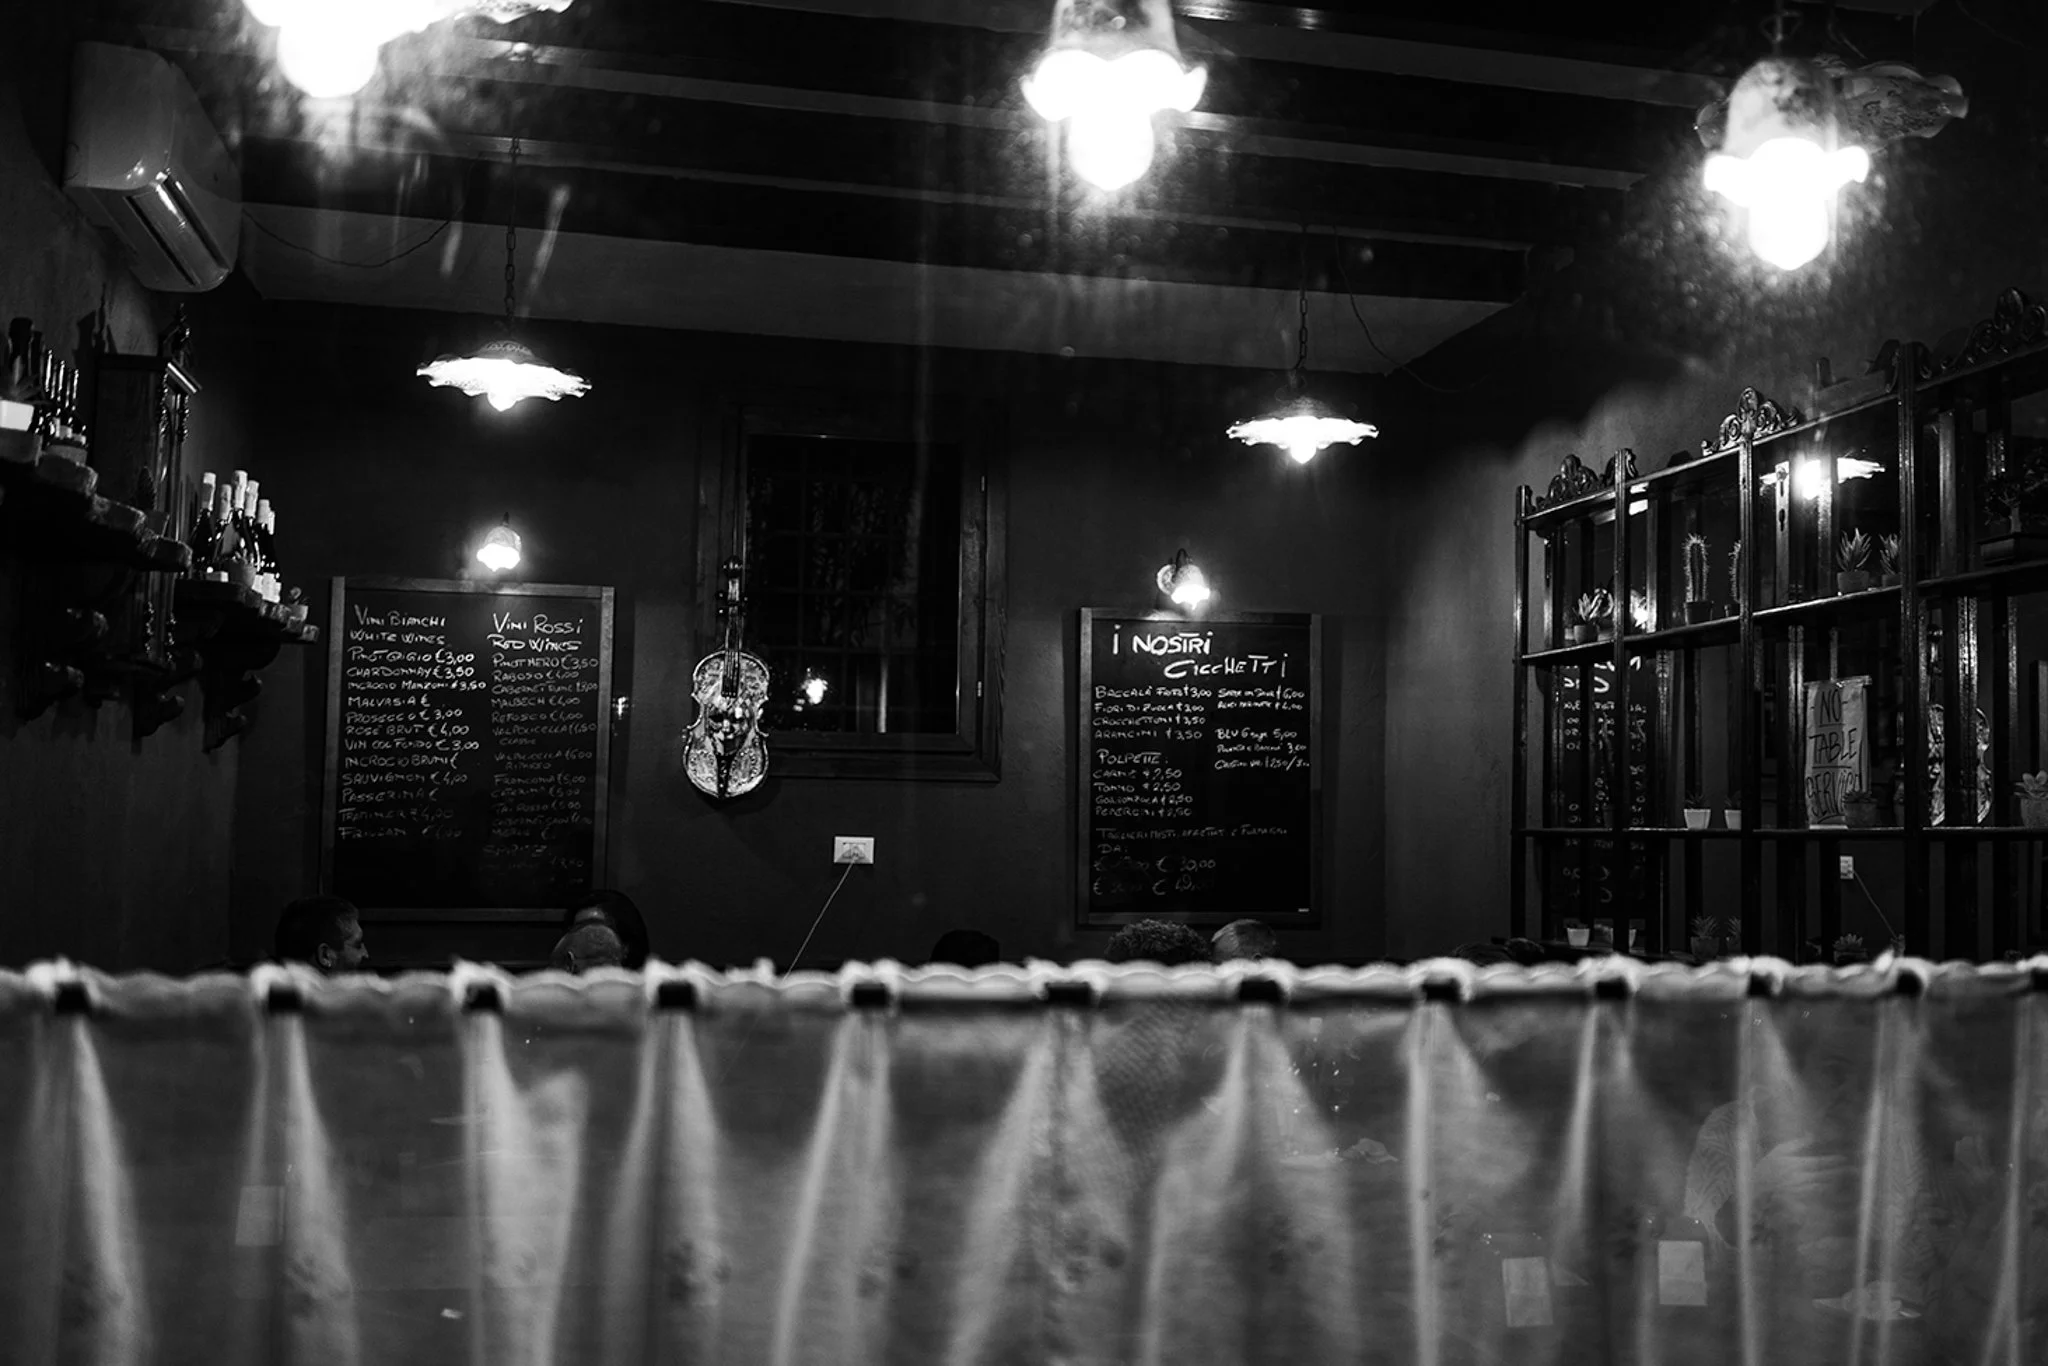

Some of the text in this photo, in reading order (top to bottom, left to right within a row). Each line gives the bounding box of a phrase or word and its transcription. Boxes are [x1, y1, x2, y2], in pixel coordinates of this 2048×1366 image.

[493, 611, 584, 634] VINI ROSSI
[350, 629, 445, 645] WHITE WINES
[1132, 631, 1214, 656] NOSTRI
[1163, 653, 1289, 679] CICCHETTI
[1820, 688, 1842, 724] NO
[1809, 728, 1857, 765] TABLE
